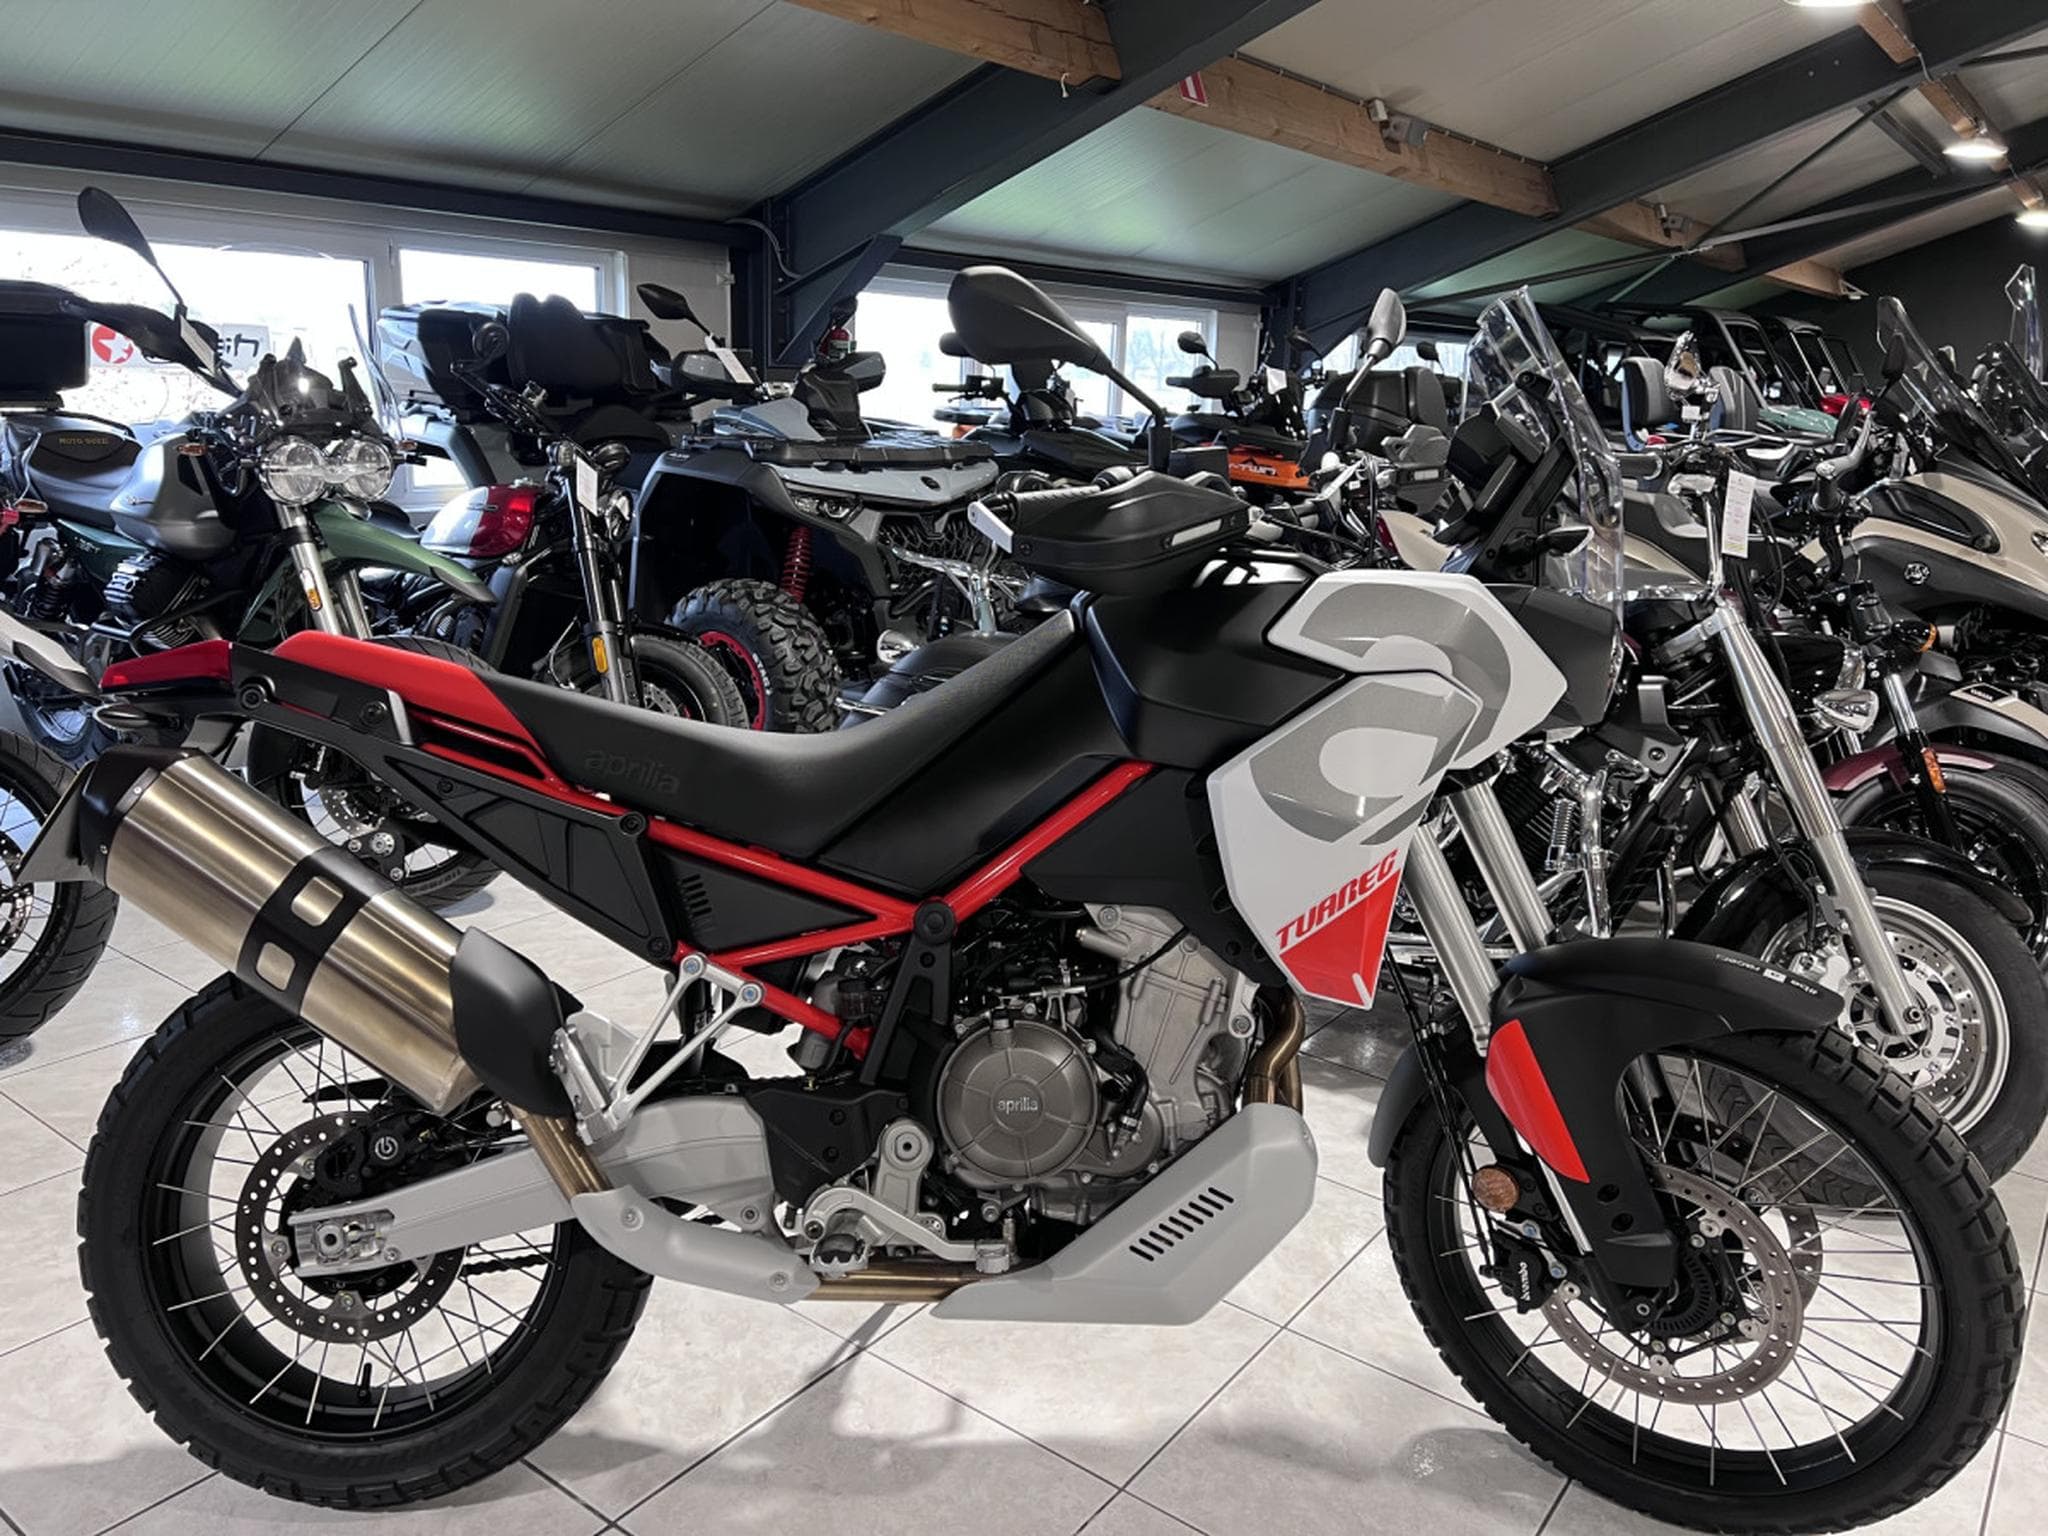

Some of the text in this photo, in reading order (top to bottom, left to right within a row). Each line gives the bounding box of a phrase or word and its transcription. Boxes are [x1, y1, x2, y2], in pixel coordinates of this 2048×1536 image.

[584, 750, 681, 794] aprilia
[1276, 848, 1399, 949] TUAREG
[998, 1096, 1039, 1115] aprilia
